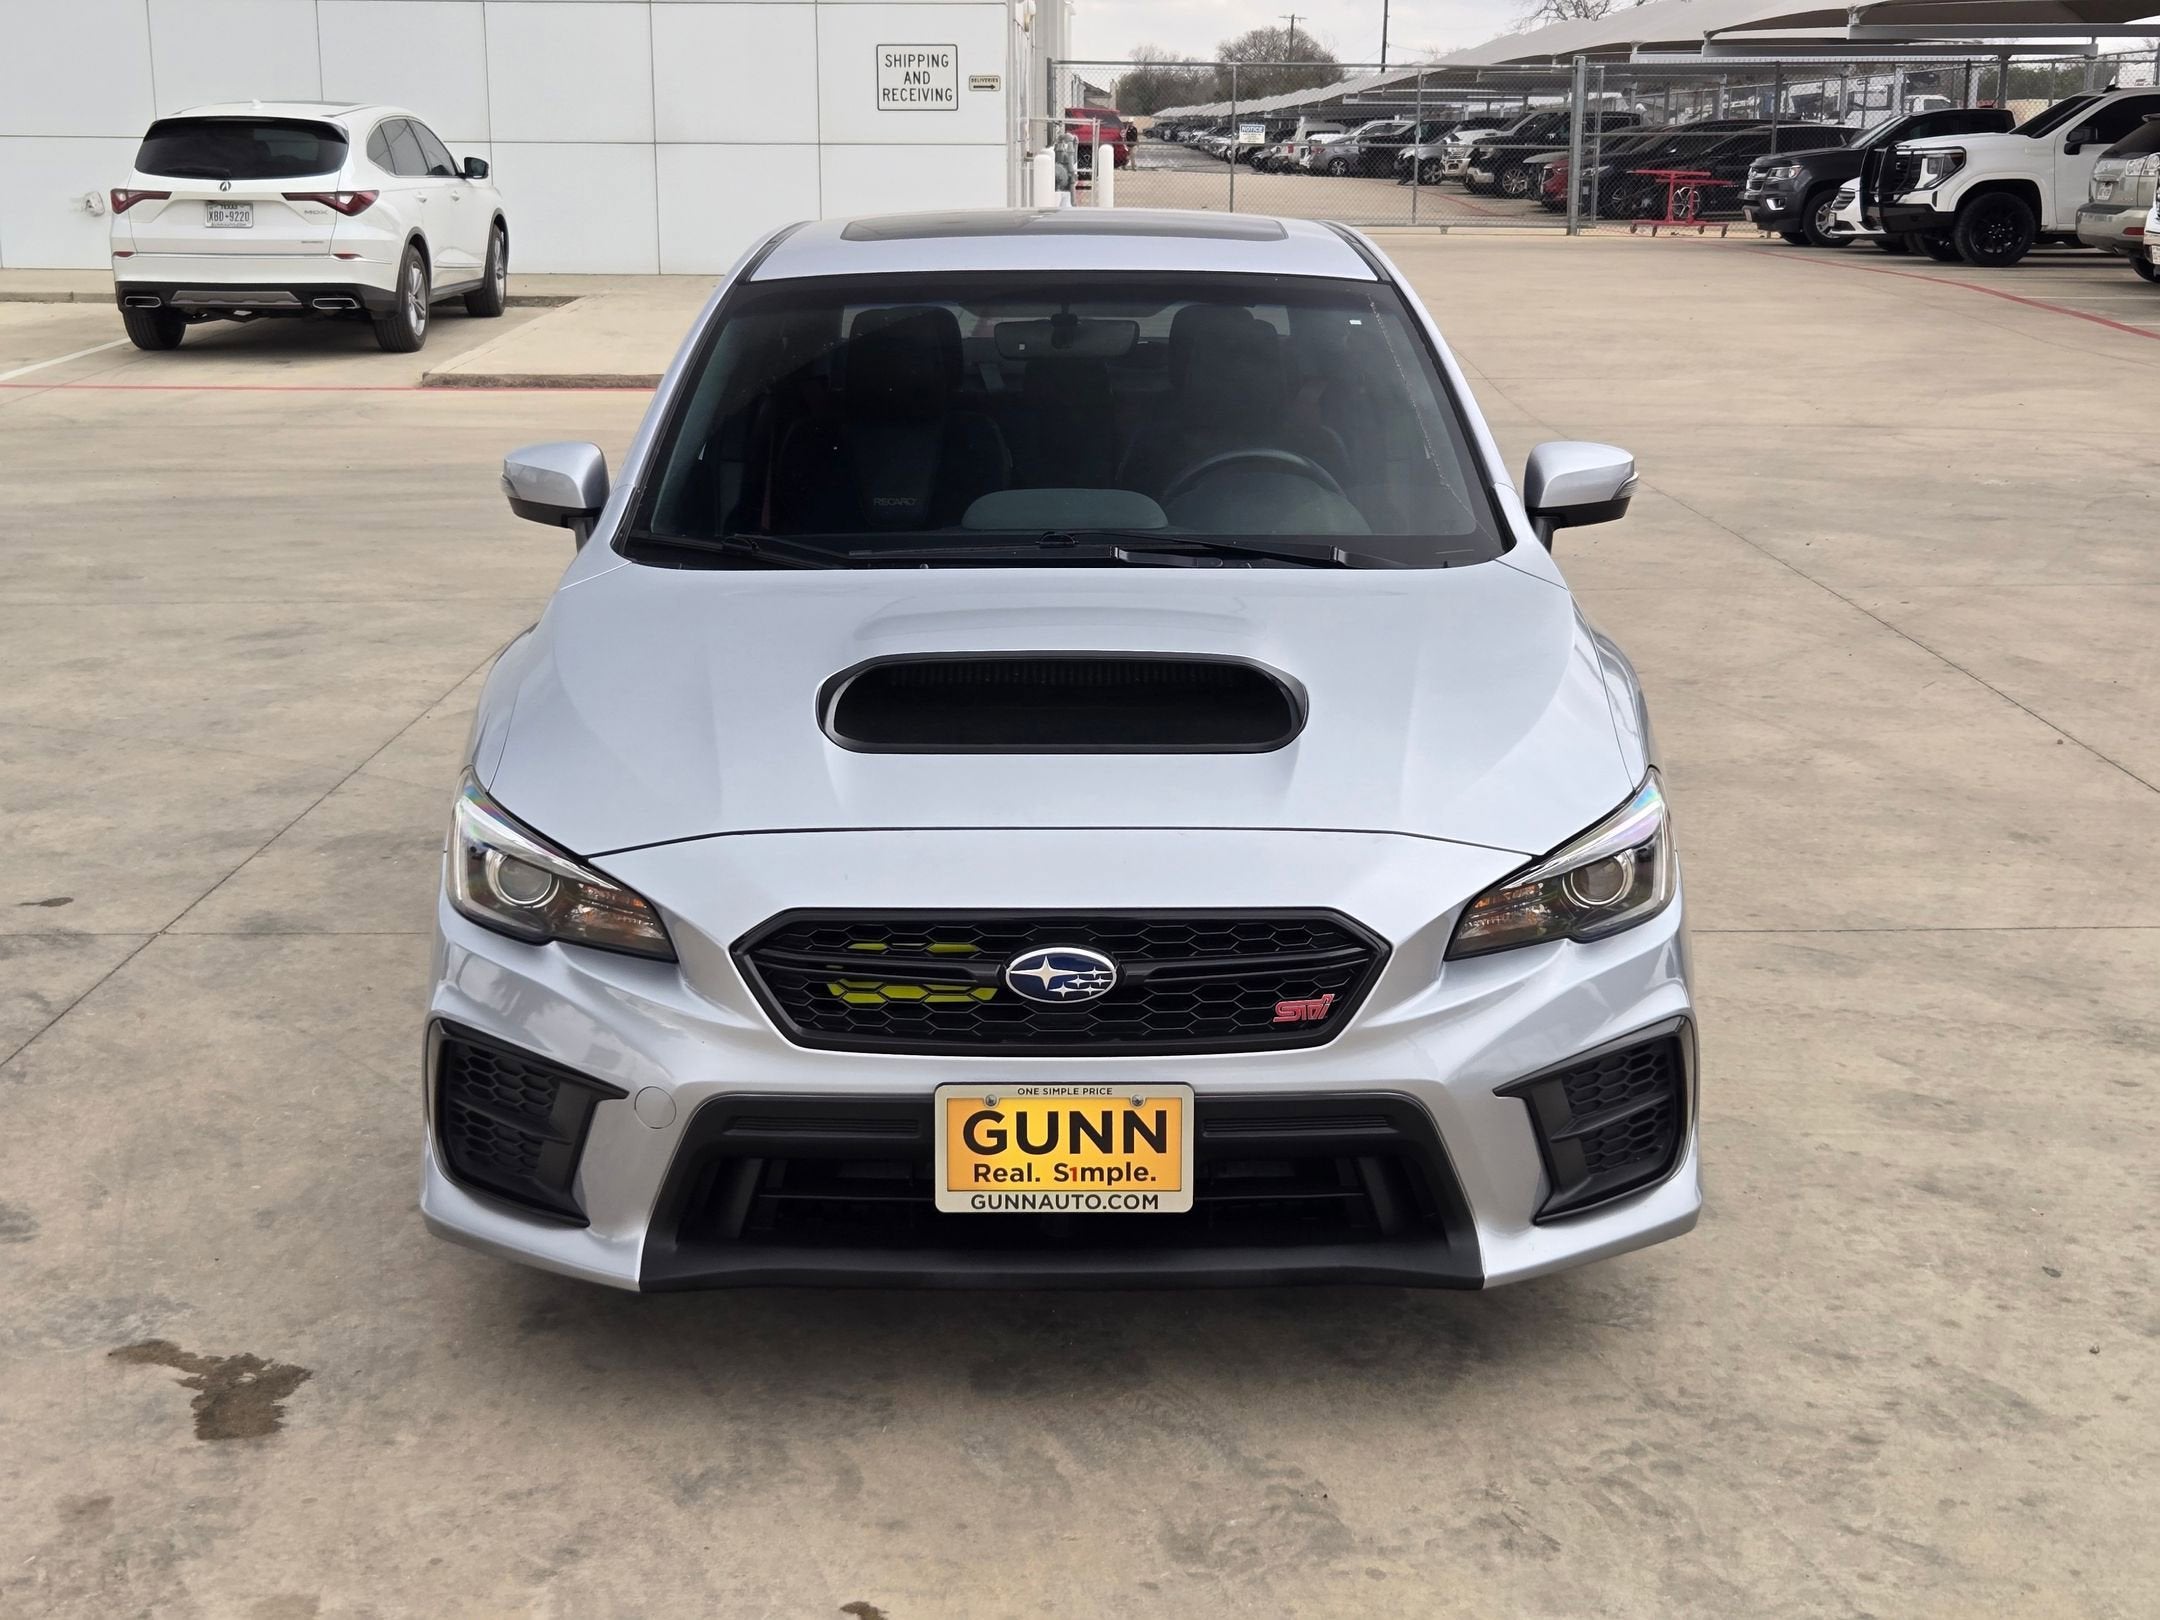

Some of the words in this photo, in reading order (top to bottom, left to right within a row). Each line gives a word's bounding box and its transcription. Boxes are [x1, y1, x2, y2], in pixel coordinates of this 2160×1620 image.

[884, 54, 949, 68] SHIPPING
[903, 71, 931, 85] AND
[882, 88, 953, 102] RECEIVING
[1017, 1087, 1040, 1096] ONE
[1042, 1087, 1080, 1096] SIMPLE
[1082, 1087, 1113, 1096] PRICE
[962, 1109, 1167, 1156] GUNN
[973, 1163, 1041, 1183] Real.
[970, 1193, 1159, 1211] GUNNAUTO.COM
